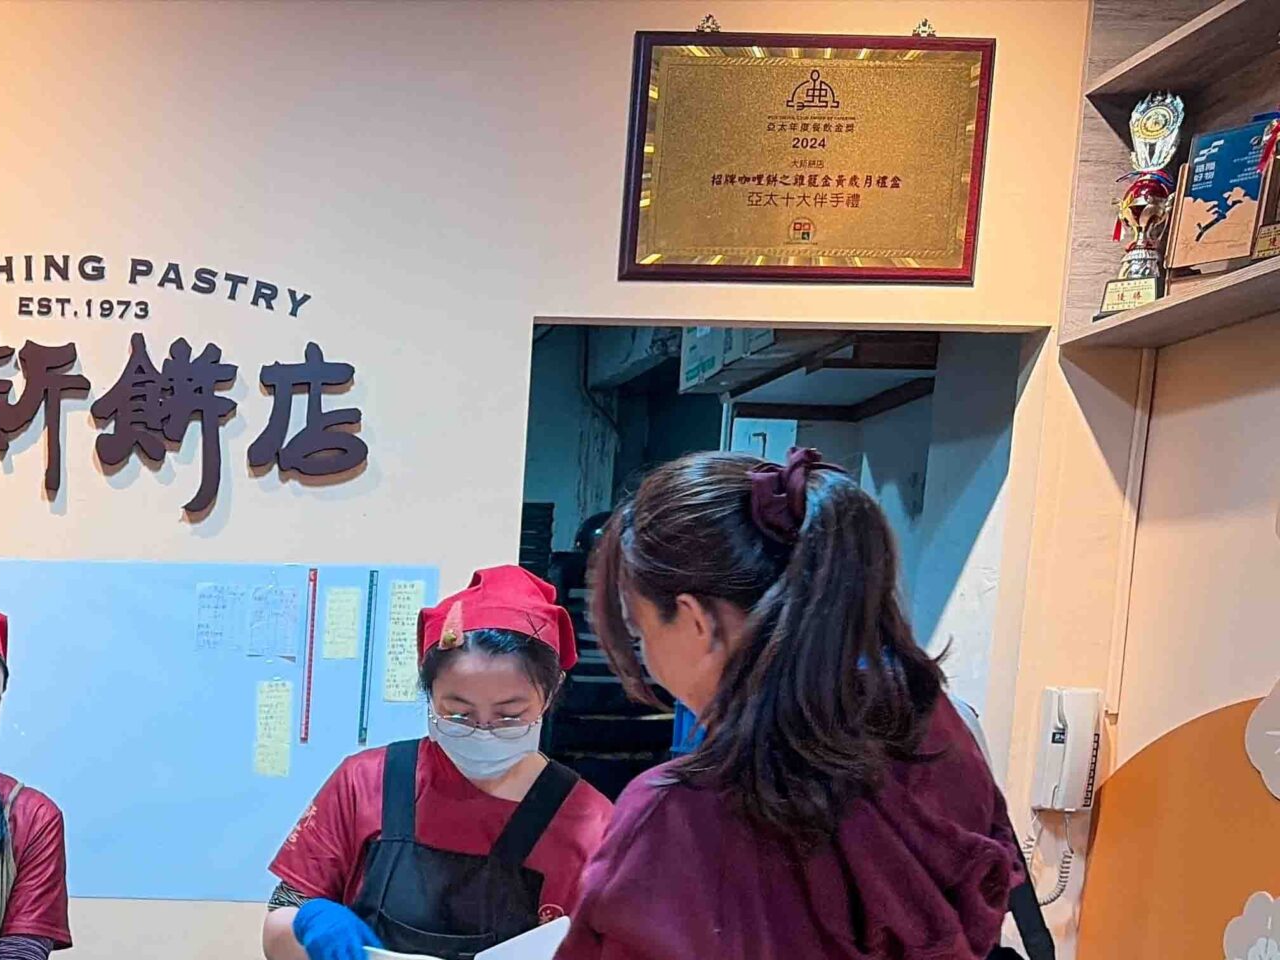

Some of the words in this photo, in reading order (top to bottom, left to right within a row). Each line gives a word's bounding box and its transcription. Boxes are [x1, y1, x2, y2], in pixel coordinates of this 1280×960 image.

[792, 137, 827, 149] 2024
[746, 191, 862, 208] 亞太十大伴手禮
[130, 258, 312, 318] PASTRY
[17, 296, 150, 320] EST.1973
